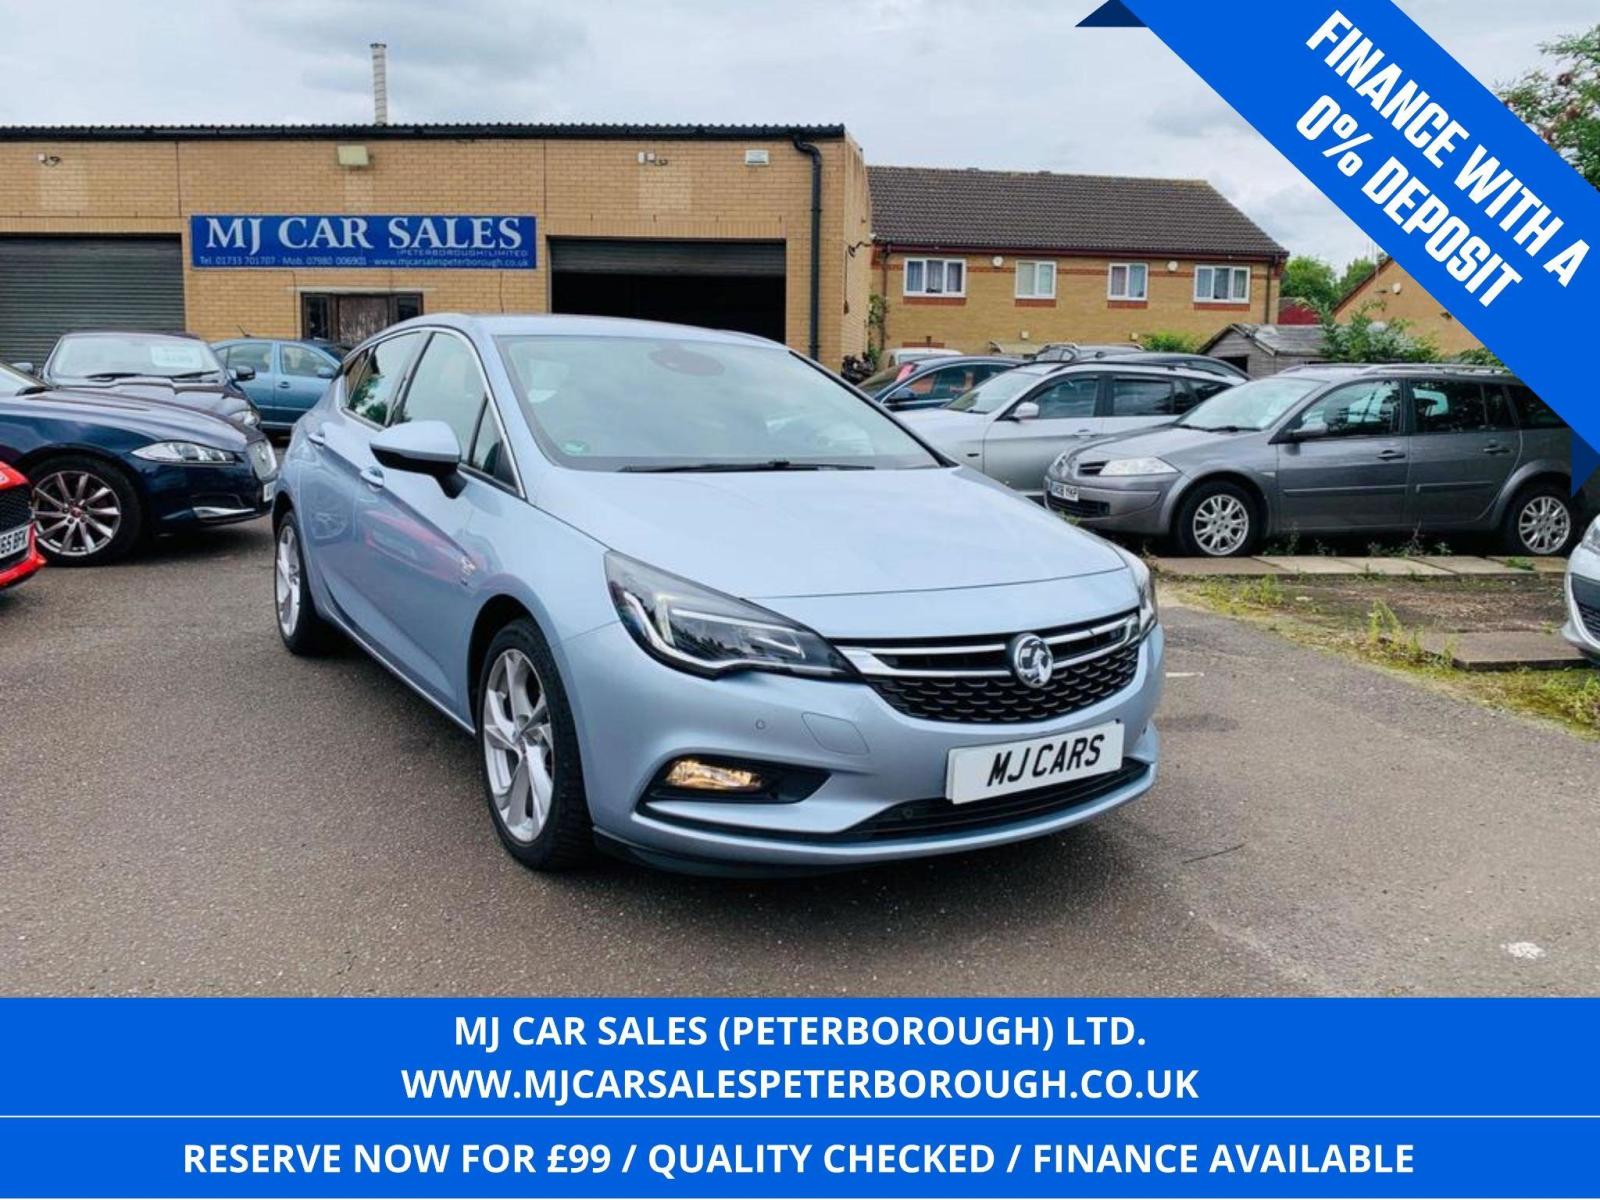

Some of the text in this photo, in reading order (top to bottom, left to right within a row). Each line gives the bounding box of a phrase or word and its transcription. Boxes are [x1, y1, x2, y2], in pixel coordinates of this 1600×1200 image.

[205, 216, 522, 256] MJ CAR SALES
[215, 256, 242, 265] 01733
[987, 733, 1105, 787] MJ CARS
